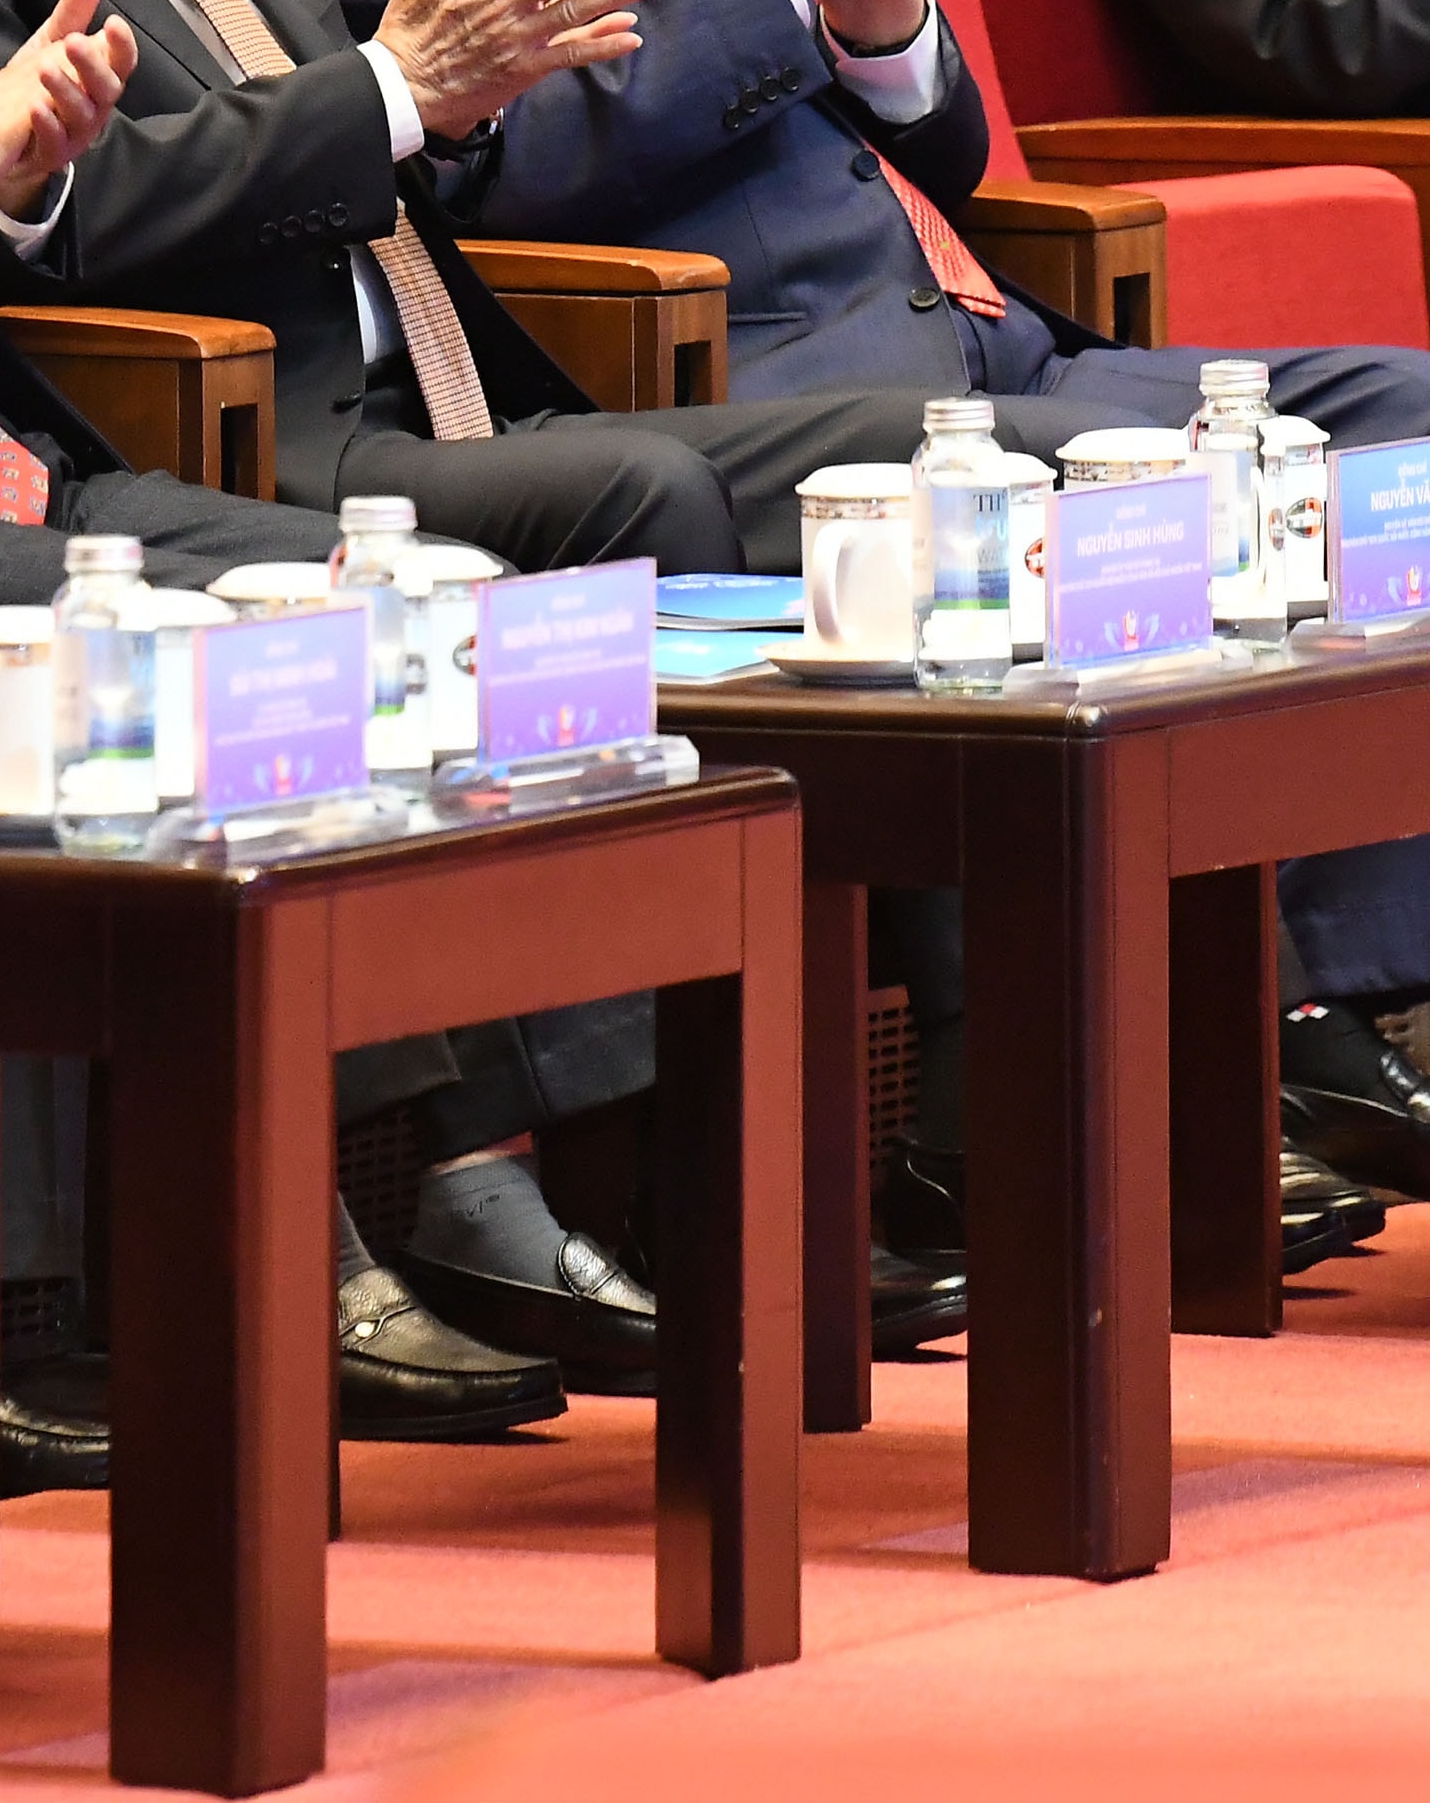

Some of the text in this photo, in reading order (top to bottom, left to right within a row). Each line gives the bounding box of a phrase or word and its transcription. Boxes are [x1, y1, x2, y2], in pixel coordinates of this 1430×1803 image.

[1370, 478, 1415, 511] NGUYỄN
[1123, 526, 1151, 550] SINH
[1152, 518, 1185, 545] HÙNG
